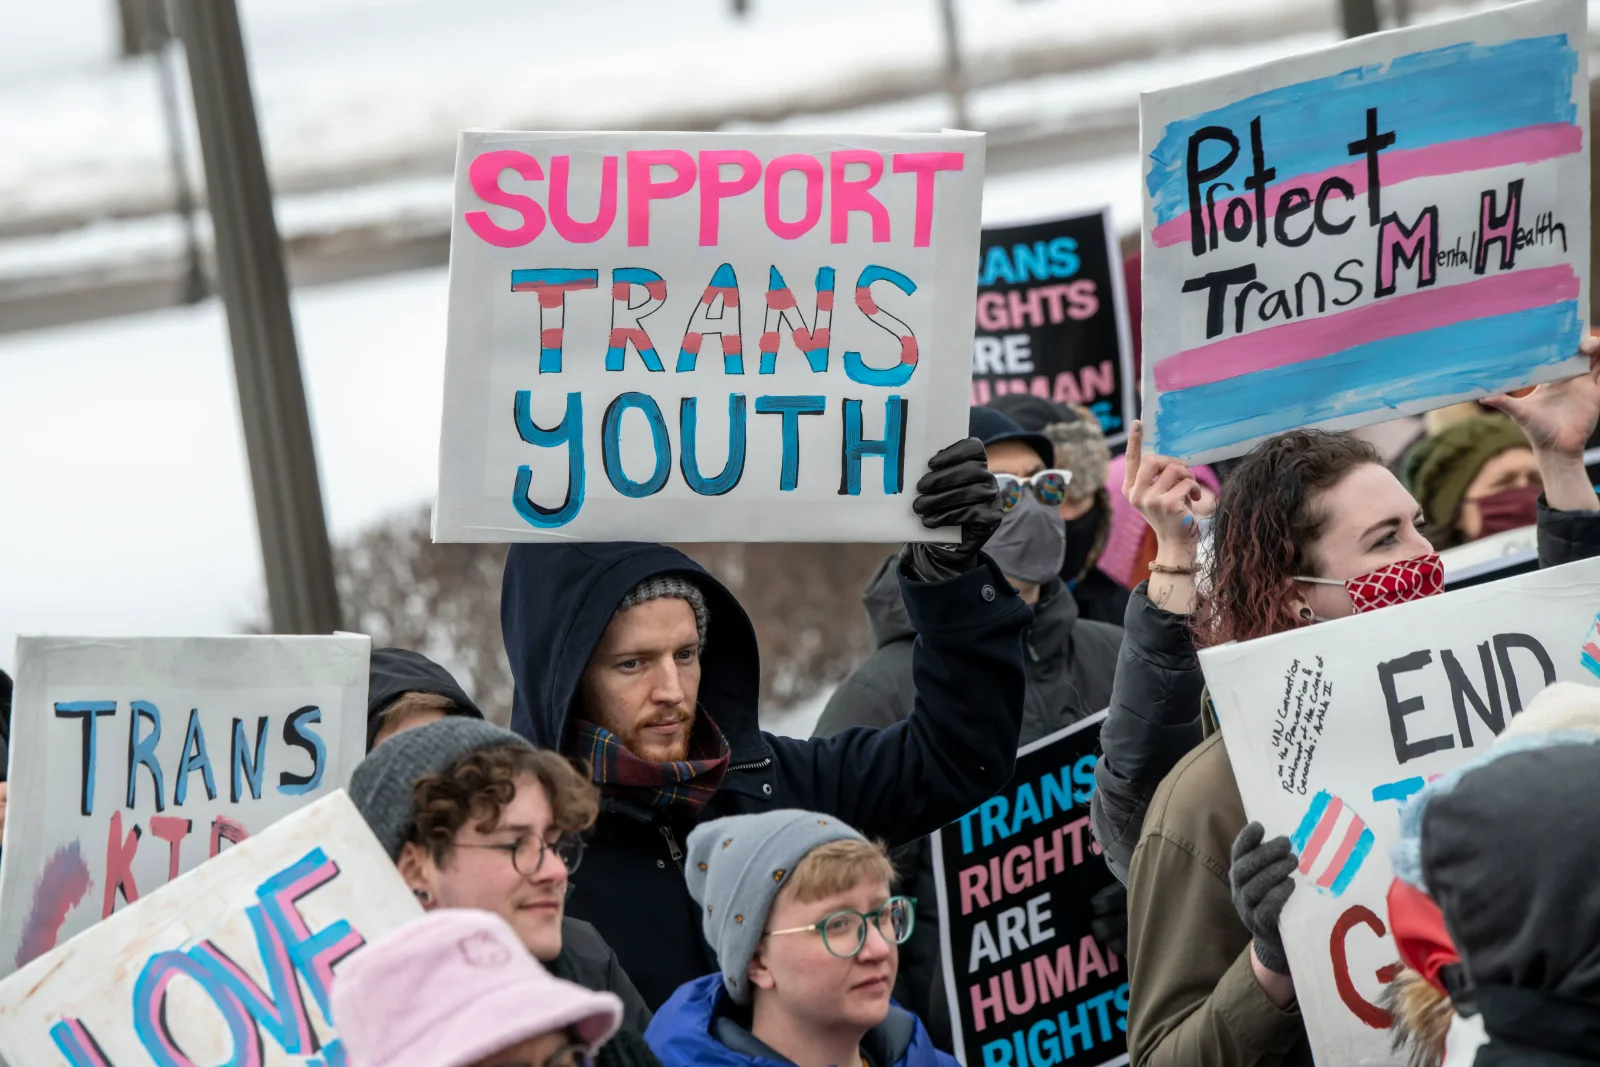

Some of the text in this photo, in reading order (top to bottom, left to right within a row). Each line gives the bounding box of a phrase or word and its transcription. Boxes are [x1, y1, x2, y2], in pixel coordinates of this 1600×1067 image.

[465, 149, 964, 248] SUPPORT
[1186, 107, 1396, 256] Protect
[976, 279, 1099, 331] GHTS
[978, 236, 1080, 285] ANS
[1181, 177, 1568, 340] Trans Mental Health
[511, 262, 918, 387] TRANS
[973, 334, 1035, 374] RE
[512, 390, 908, 528] YOUTH
[1272, 659, 1300, 747] UN Convention
[1285, 680, 1309, 746] Prevention
[1310, 671, 1322, 703] Crime
[1377, 632, 1557, 765] END
[54, 700, 327, 816] TRANS
[951, 754, 1099, 855] TRANS
[101, 809, 250, 920] KI
[958, 815, 1103, 916] RIGHT
[968, 892, 1056, 973] ARE
[981, 982, 1130, 1067] RIGHTS
